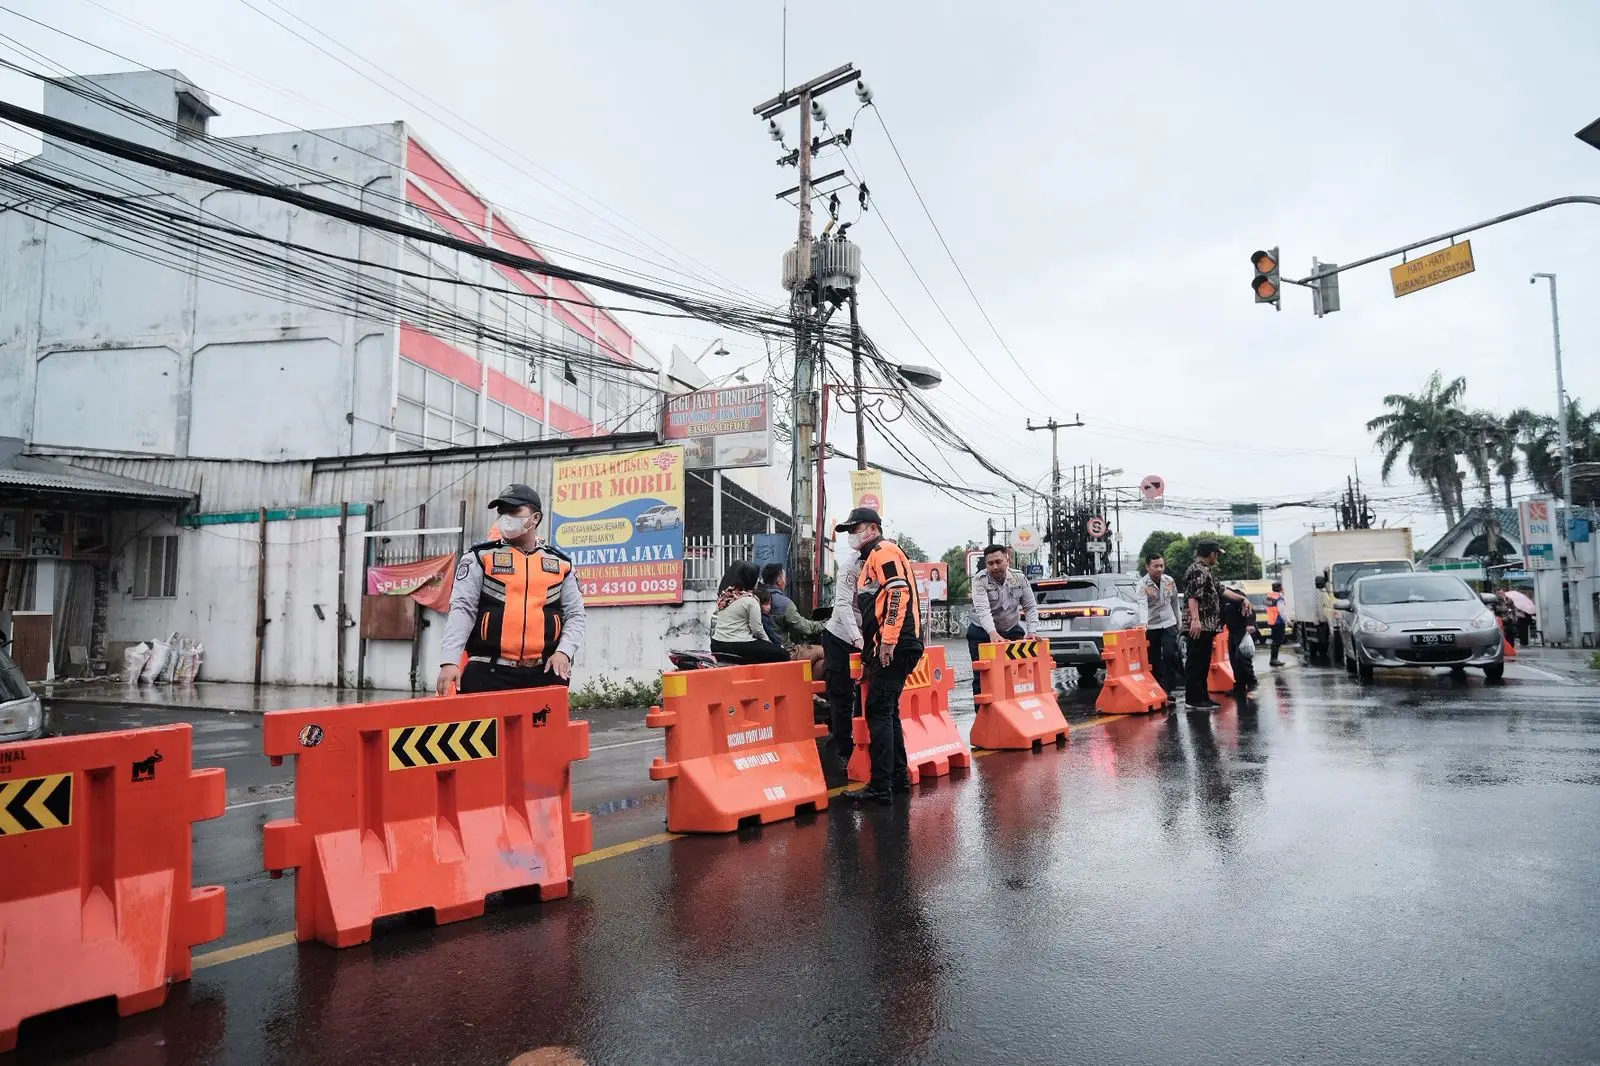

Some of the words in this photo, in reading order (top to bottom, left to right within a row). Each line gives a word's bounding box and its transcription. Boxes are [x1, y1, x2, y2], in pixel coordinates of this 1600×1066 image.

[1407, 261, 1423, 274] HATI
[1428, 254, 1445, 267] HATI
[1395, 275, 1426, 293] KURANGI
[1427, 260, 1471, 280] KECEPATAN
[668, 395, 690, 413] TUGU
[692, 392, 712, 411] JAYA
[714, 386, 765, 407] FURNITURE
[559, 463, 607, 480] PUSATNYA
[609, 456, 650, 475] KURSUS
[556, 480, 603, 502] STIR
[609, 472, 677, 497] MOBIL
[1529, 524, 1548, 534] BNI
[631, 543, 674, 562] JAYA
[601, 581, 636, 594] 4310
[640, 578, 678, 592] 0039
[0, 749, 28, 764] INAL
